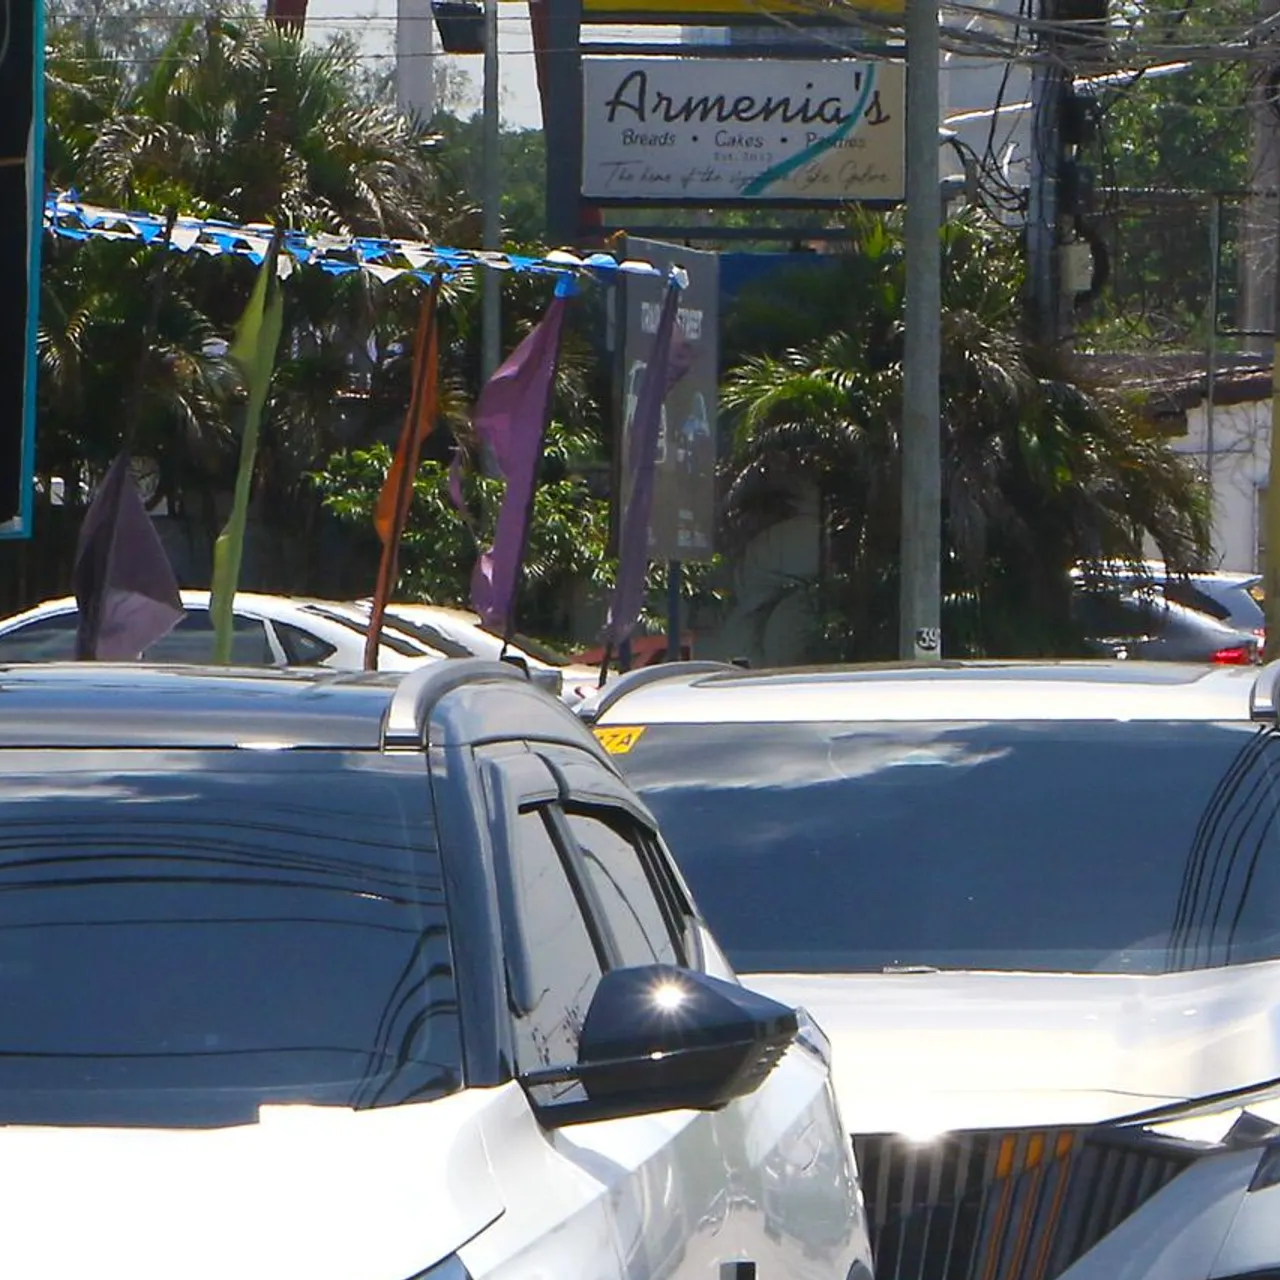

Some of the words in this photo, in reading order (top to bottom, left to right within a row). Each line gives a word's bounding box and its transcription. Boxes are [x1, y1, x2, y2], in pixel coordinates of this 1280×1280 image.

[605, 70, 890, 126] Armenia's
[622, 128, 675, 147] Breads
[714, 131, 764, 148] Cakes
